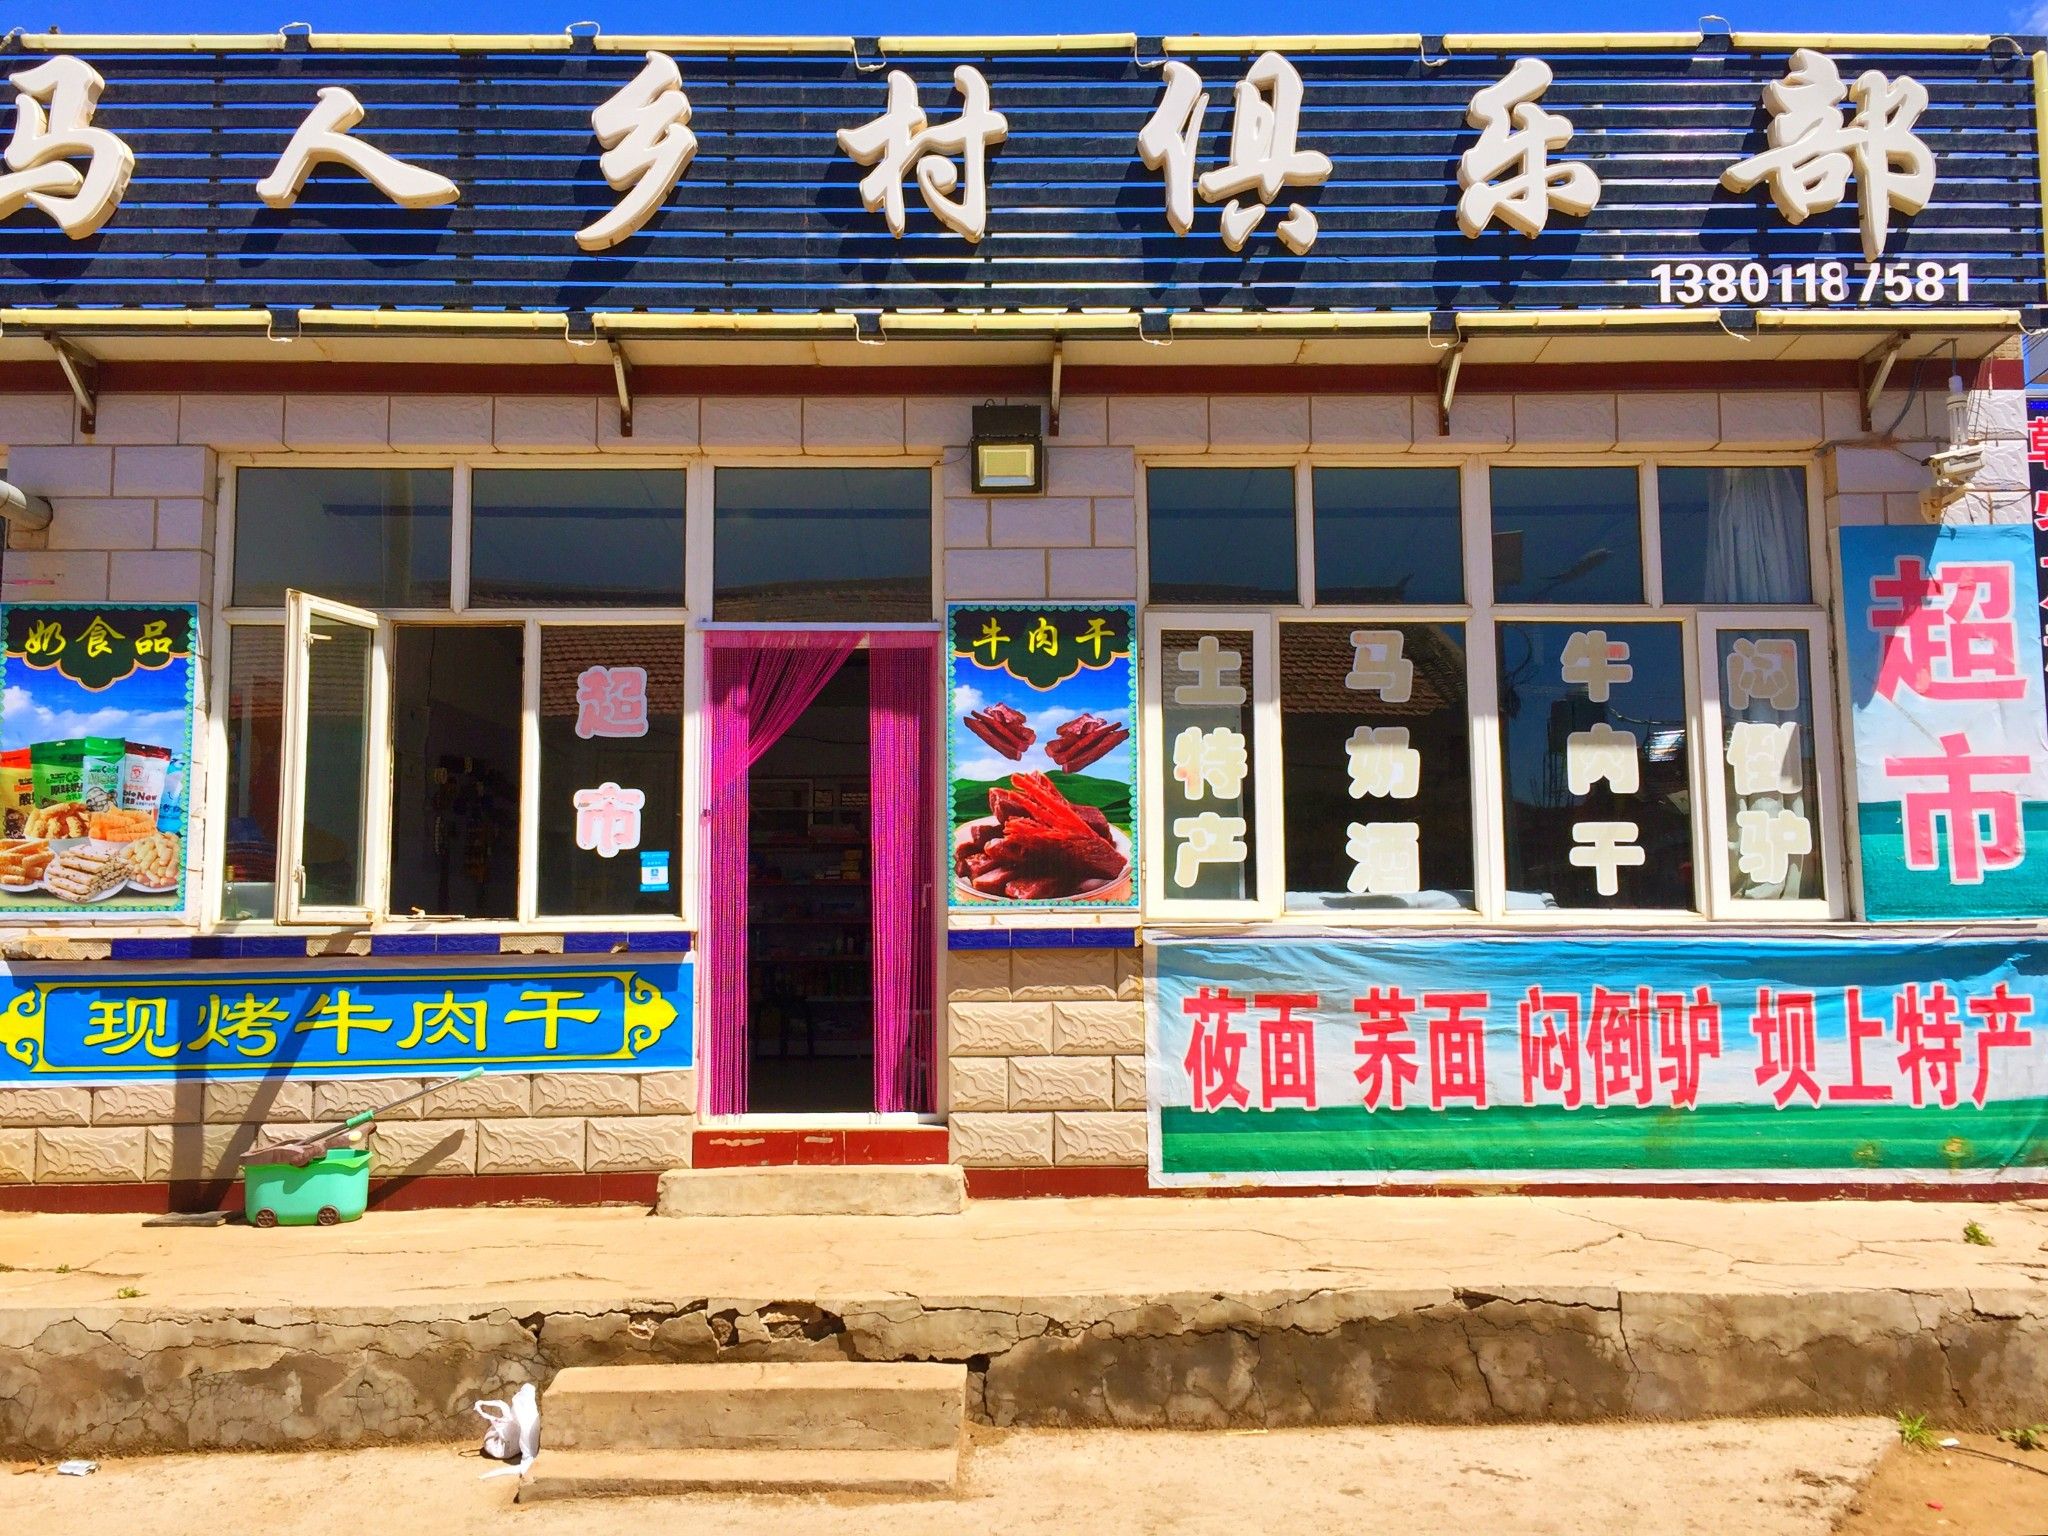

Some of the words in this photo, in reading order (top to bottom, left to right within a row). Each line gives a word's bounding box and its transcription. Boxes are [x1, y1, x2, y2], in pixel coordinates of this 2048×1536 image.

[1650, 262, 1970, 303] 13801187581
[25, 615, 173, 658] 奶食品
[973, 617, 1115, 661] 牛肉干
[575, 665, 649, 858] 超市
[1173, 635, 1248, 888] 土特产
[1345, 630, 1421, 894] 马奶酒
[1560, 630, 1646, 896] 牛肉干
[1868, 555, 2032, 886] 超市
[83, 989, 600, 1057] 现烤牛肉干
[1182, 986, 1318, 1110] 莜面
[1352, 986, 1489, 1110] 荞面
[1519, 985, 1721, 1108] 闷倒驴
[1751, 982, 2033, 1107] 坝上特产
